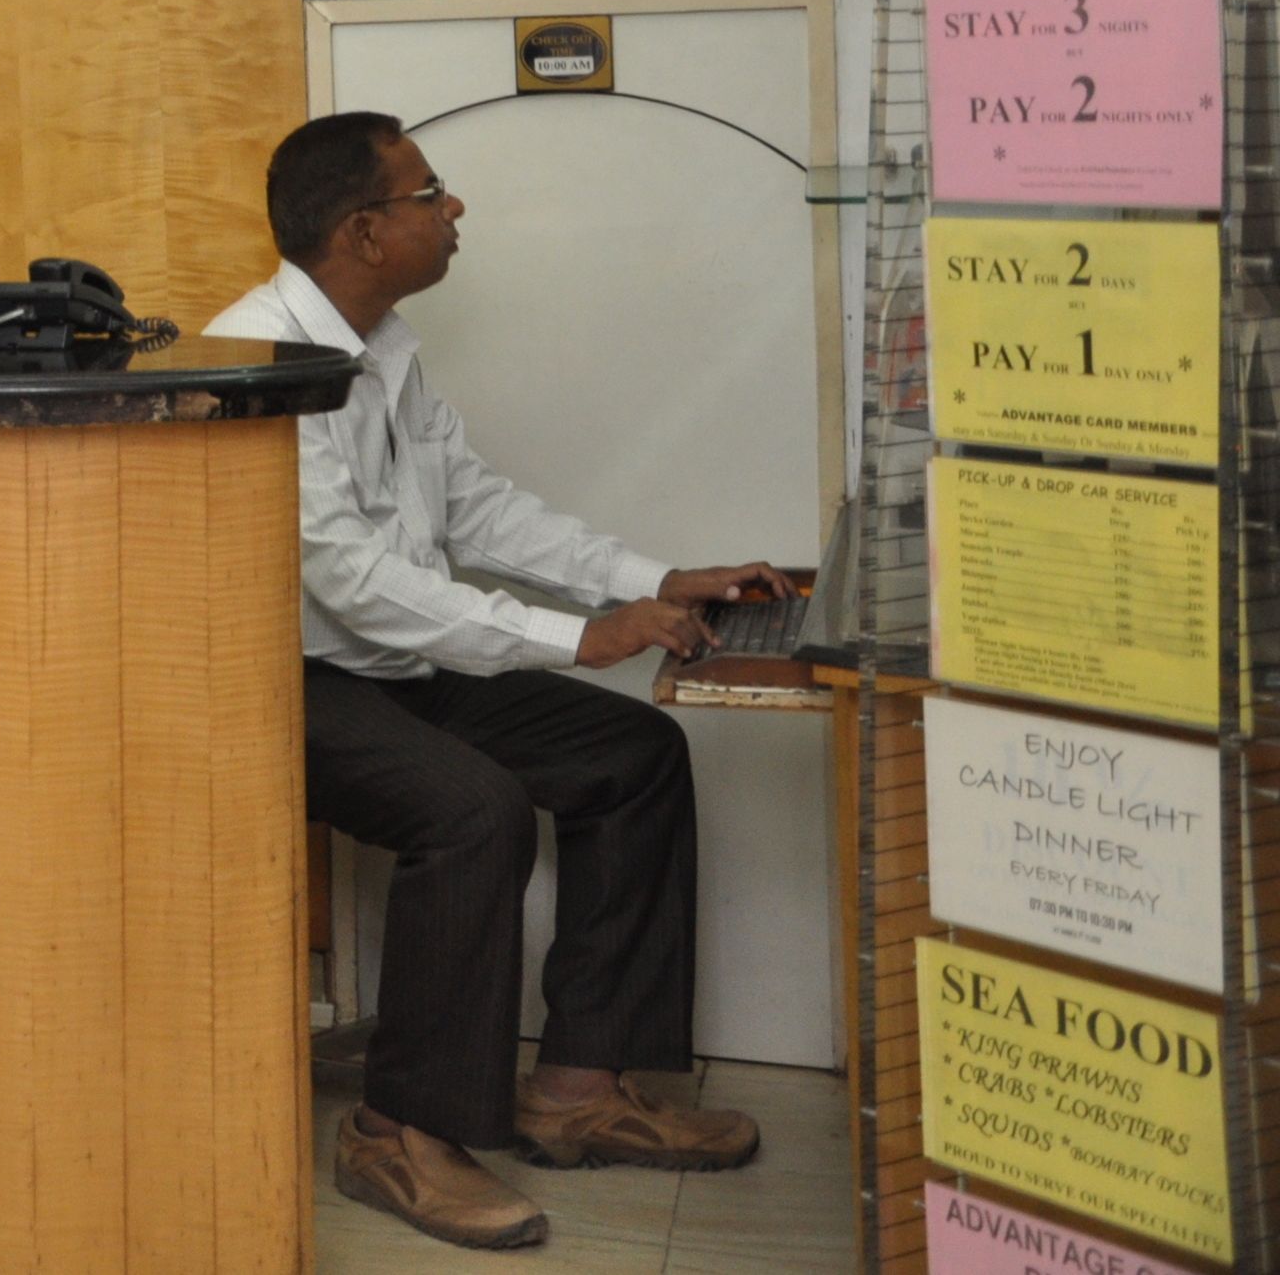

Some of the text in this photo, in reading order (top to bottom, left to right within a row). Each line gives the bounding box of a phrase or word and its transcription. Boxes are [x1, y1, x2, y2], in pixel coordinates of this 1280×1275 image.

[944, 11, 1027, 39] STAY
[1031, 24, 1056, 36] FOR
[1098, 20, 1149, 33] NIGHTS
[537, 60, 591, 71] 10:00 AM
[969, 75, 1194, 125] PAY FOR 2 NIGHTS ONLY
[947, 243, 1135, 290] STAY FOR 2 DAYS
[972, 329, 1173, 383] PAY FOR 1 DAY ONLY
[988, 428, 1027, 443] Saturday
[1042, 433, 1077, 447] Sunday
[1096, 438, 1132, 451] Sunday
[1149, 443, 1190, 457] Monday
[1001, 409, 1082, 426] ADVANTAGE
[1086, 416, 1123, 430] CARD
[1128, 420, 1198, 436] MEMBERS
[959, 470, 1177, 507] PICK-UP & DROP CAR SERVICE
[1025, 733, 1124, 782] ENJOY
[959, 765, 1202, 834] CANDLE LIGHT
[1013, 821, 1144, 869] DINNER
[1010, 860, 1161, 915] EVERY FRIDAY
[1059, 905, 1073, 918] PM
[1076, 909, 1088, 923] TO
[1118, 919, 1133, 933] PM
[942, 963, 1213, 1079] SEA FOOD
[957, 1027, 1142, 1103] KING PRAWNS
[959, 1062, 1037, 1103] CRABS
[943, 1141, 995, 1169] PROUD
[1000, 1159, 1020, 1175] TO
[1024, 1168, 1075, 1196] SERVE
[1079, 1190, 1117, 1213] OUR
[958, 1104, 1053, 1152] SQUIDS
[1156, 1177, 1226, 1214] DUCKS
[946, 1199, 1125, 1274] ADVANTAGE
